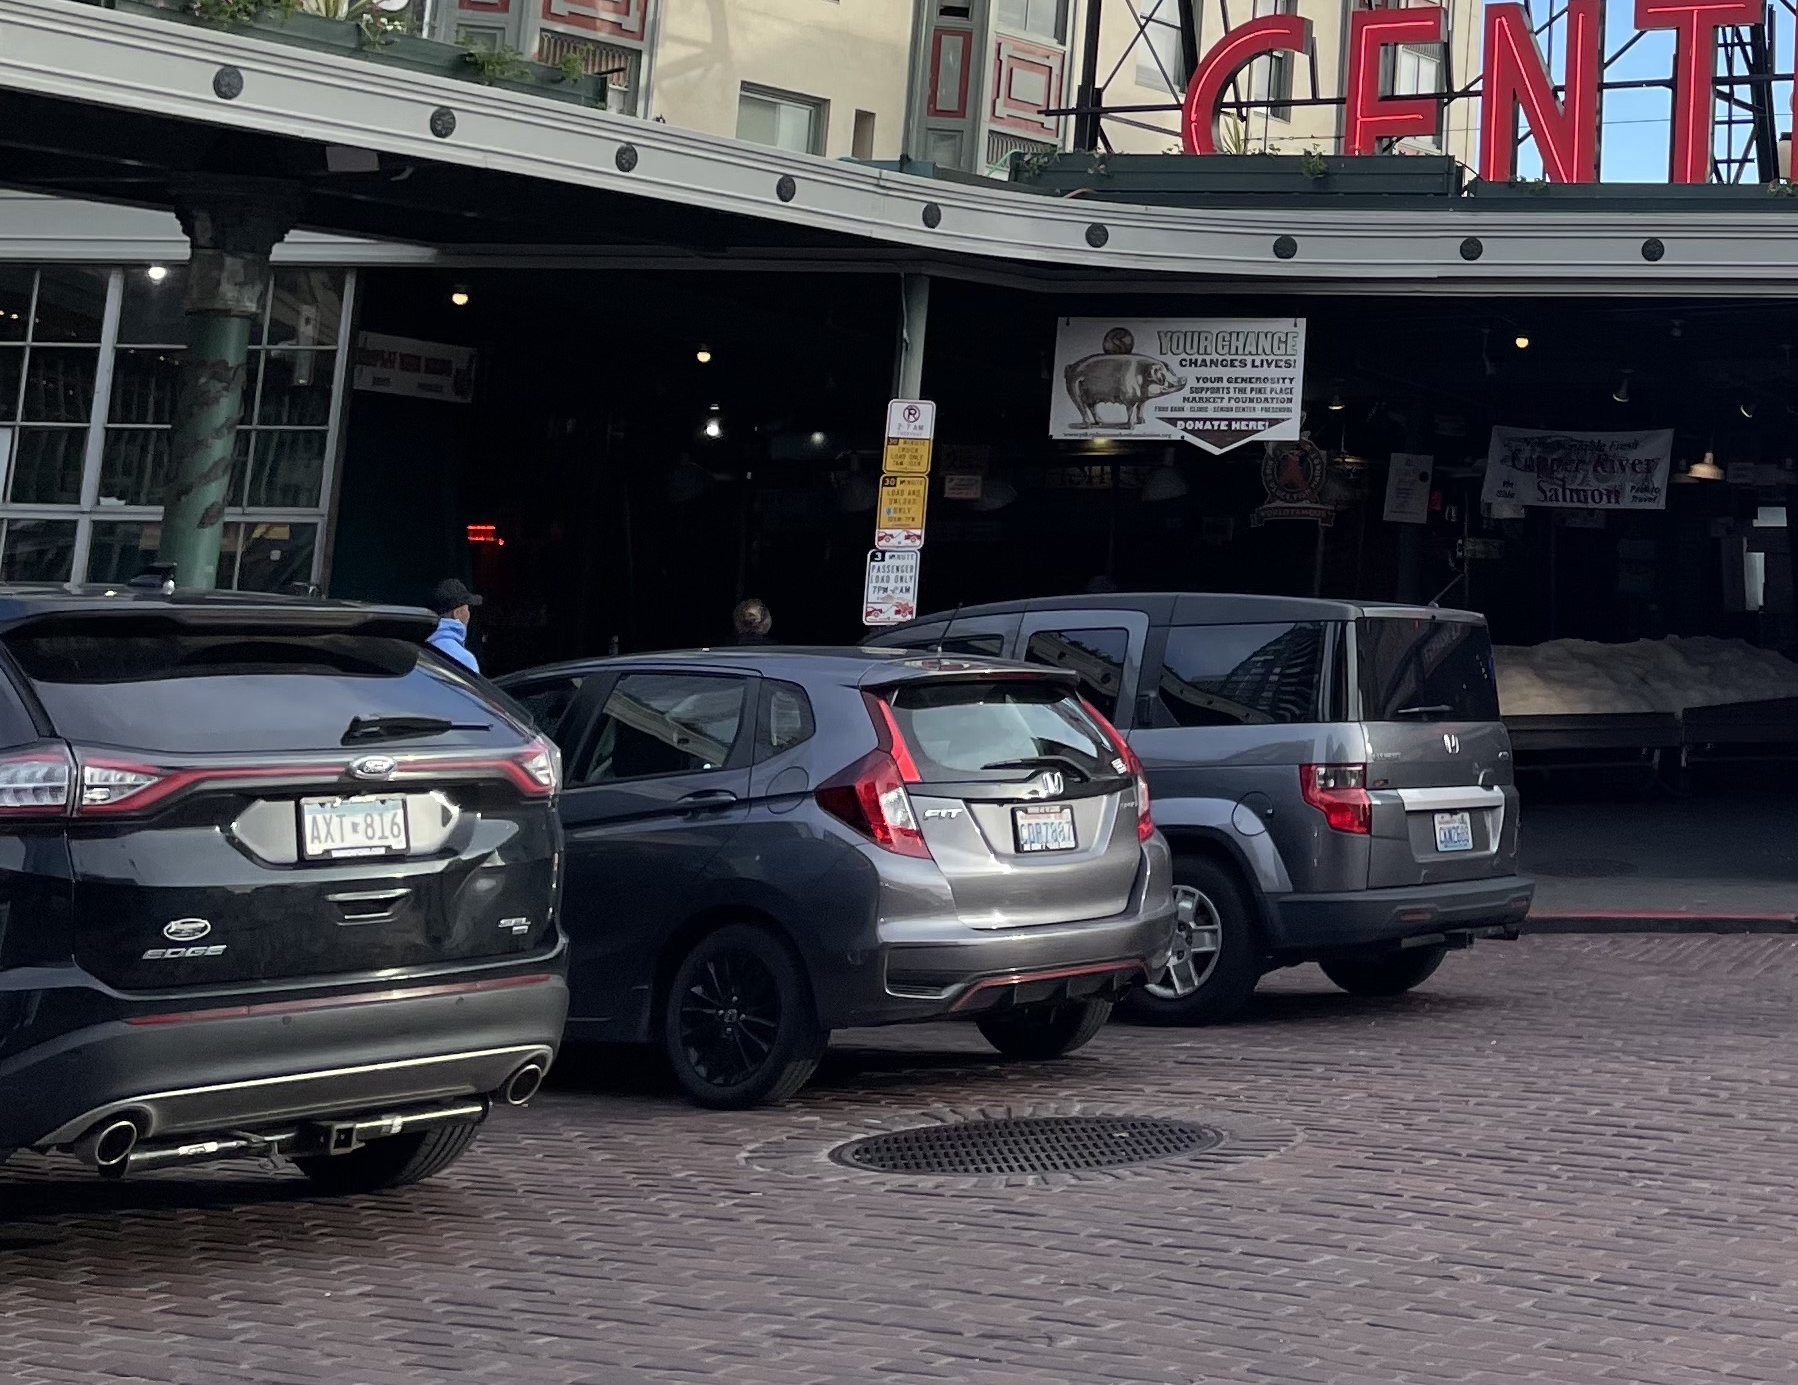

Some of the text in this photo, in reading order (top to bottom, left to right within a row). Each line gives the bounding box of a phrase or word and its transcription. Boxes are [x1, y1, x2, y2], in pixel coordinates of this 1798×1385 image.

[1157, 330, 1299, 356] YOUR CHANGE
[1179, 358, 1297, 369] CHANGES LIVES!
[1195, 376, 1295, 385] YOUR GENEROSITY
[1189, 386, 1294, 395] SUPPORTS THE PIKE PLACE
[1182, 396, 1294, 404] MARKET FOUNDATION
[1176, 420, 1270, 431] DONATE HERE!
[884, 478, 896, 486] 30
[1537, 479, 1621, 504] Salmon
[874, 552, 882, 561] 3
[871, 565, 914, 573] PASSENGER
[870, 575, 913, 584] LOAD ONLY
[923, 808, 964, 821] FIT
[311, 812, 402, 844] AXT 816
[142, 944, 228, 960] EDGE
